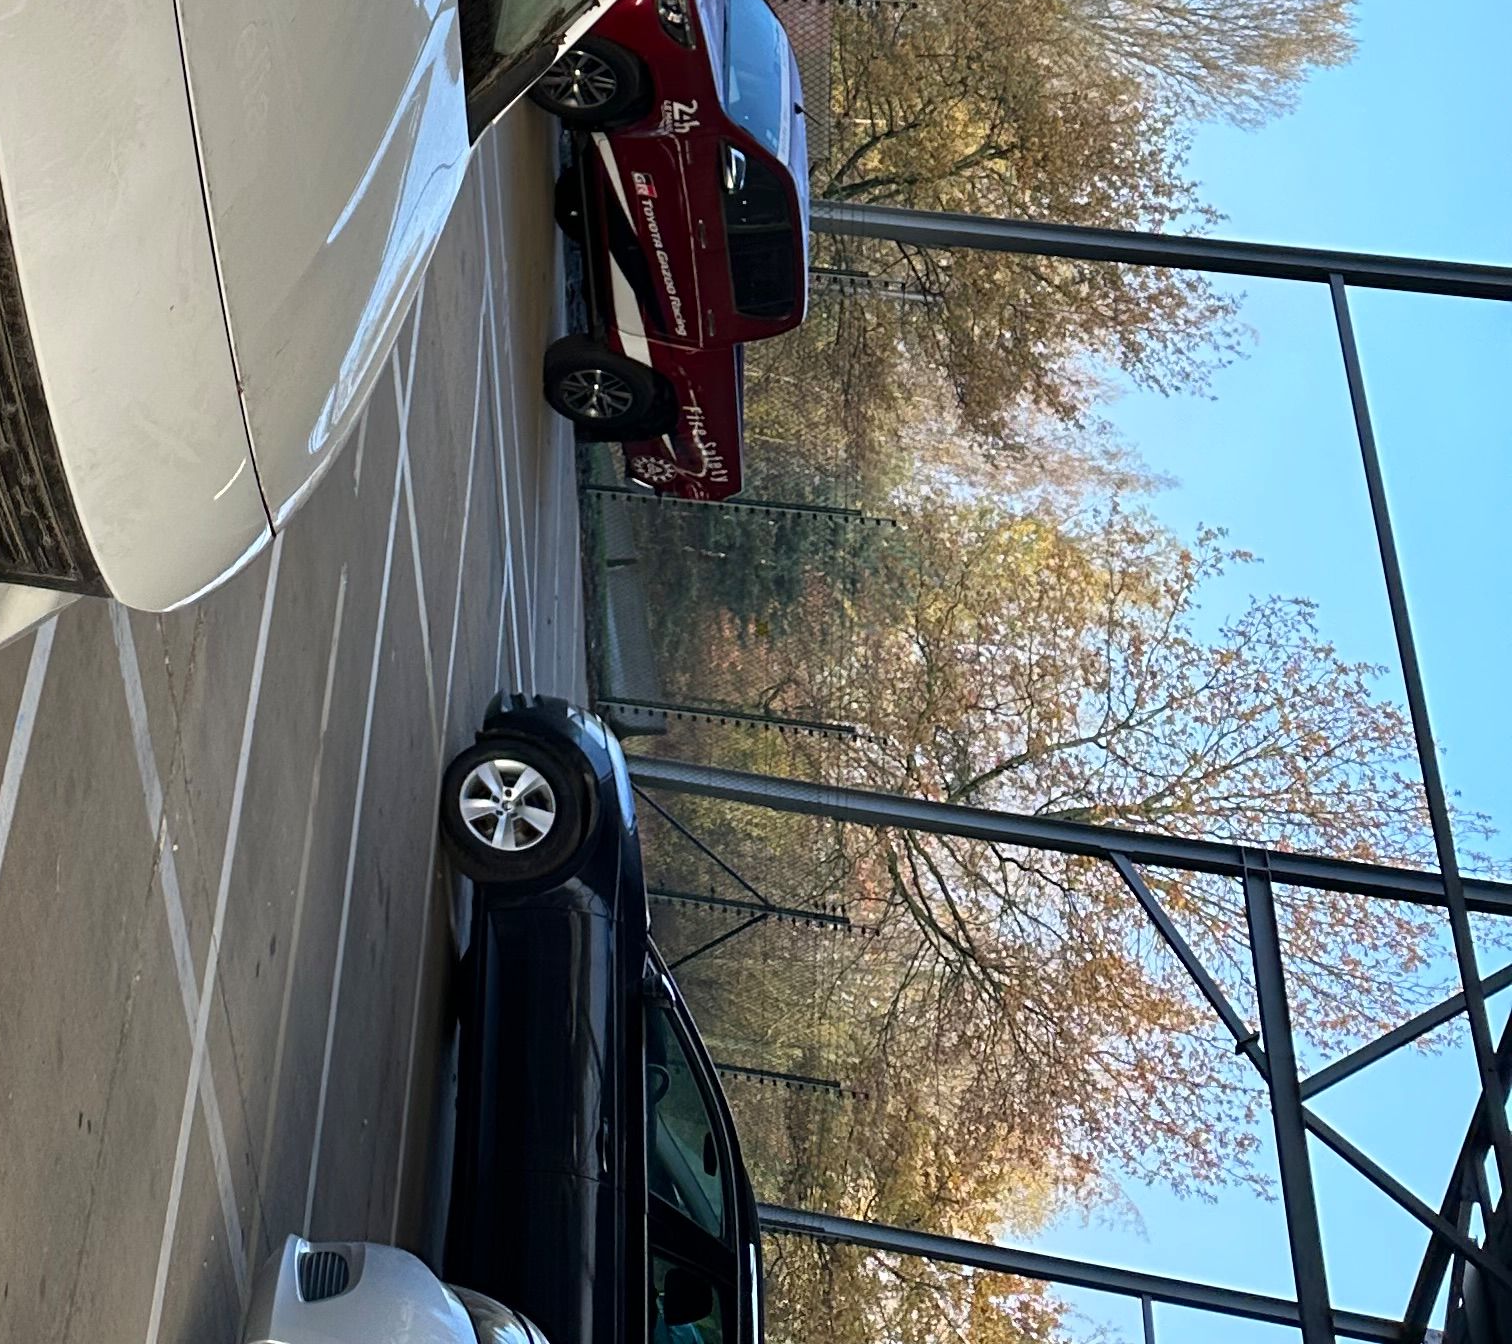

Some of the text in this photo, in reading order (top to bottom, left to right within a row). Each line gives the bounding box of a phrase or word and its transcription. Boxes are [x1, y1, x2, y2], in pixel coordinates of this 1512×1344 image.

[633, 172, 650, 196] GR
[642, 199, 663, 248] TOYOTA
[669, 296, 688, 337] Racing
[682, 406, 707, 436] Fire
